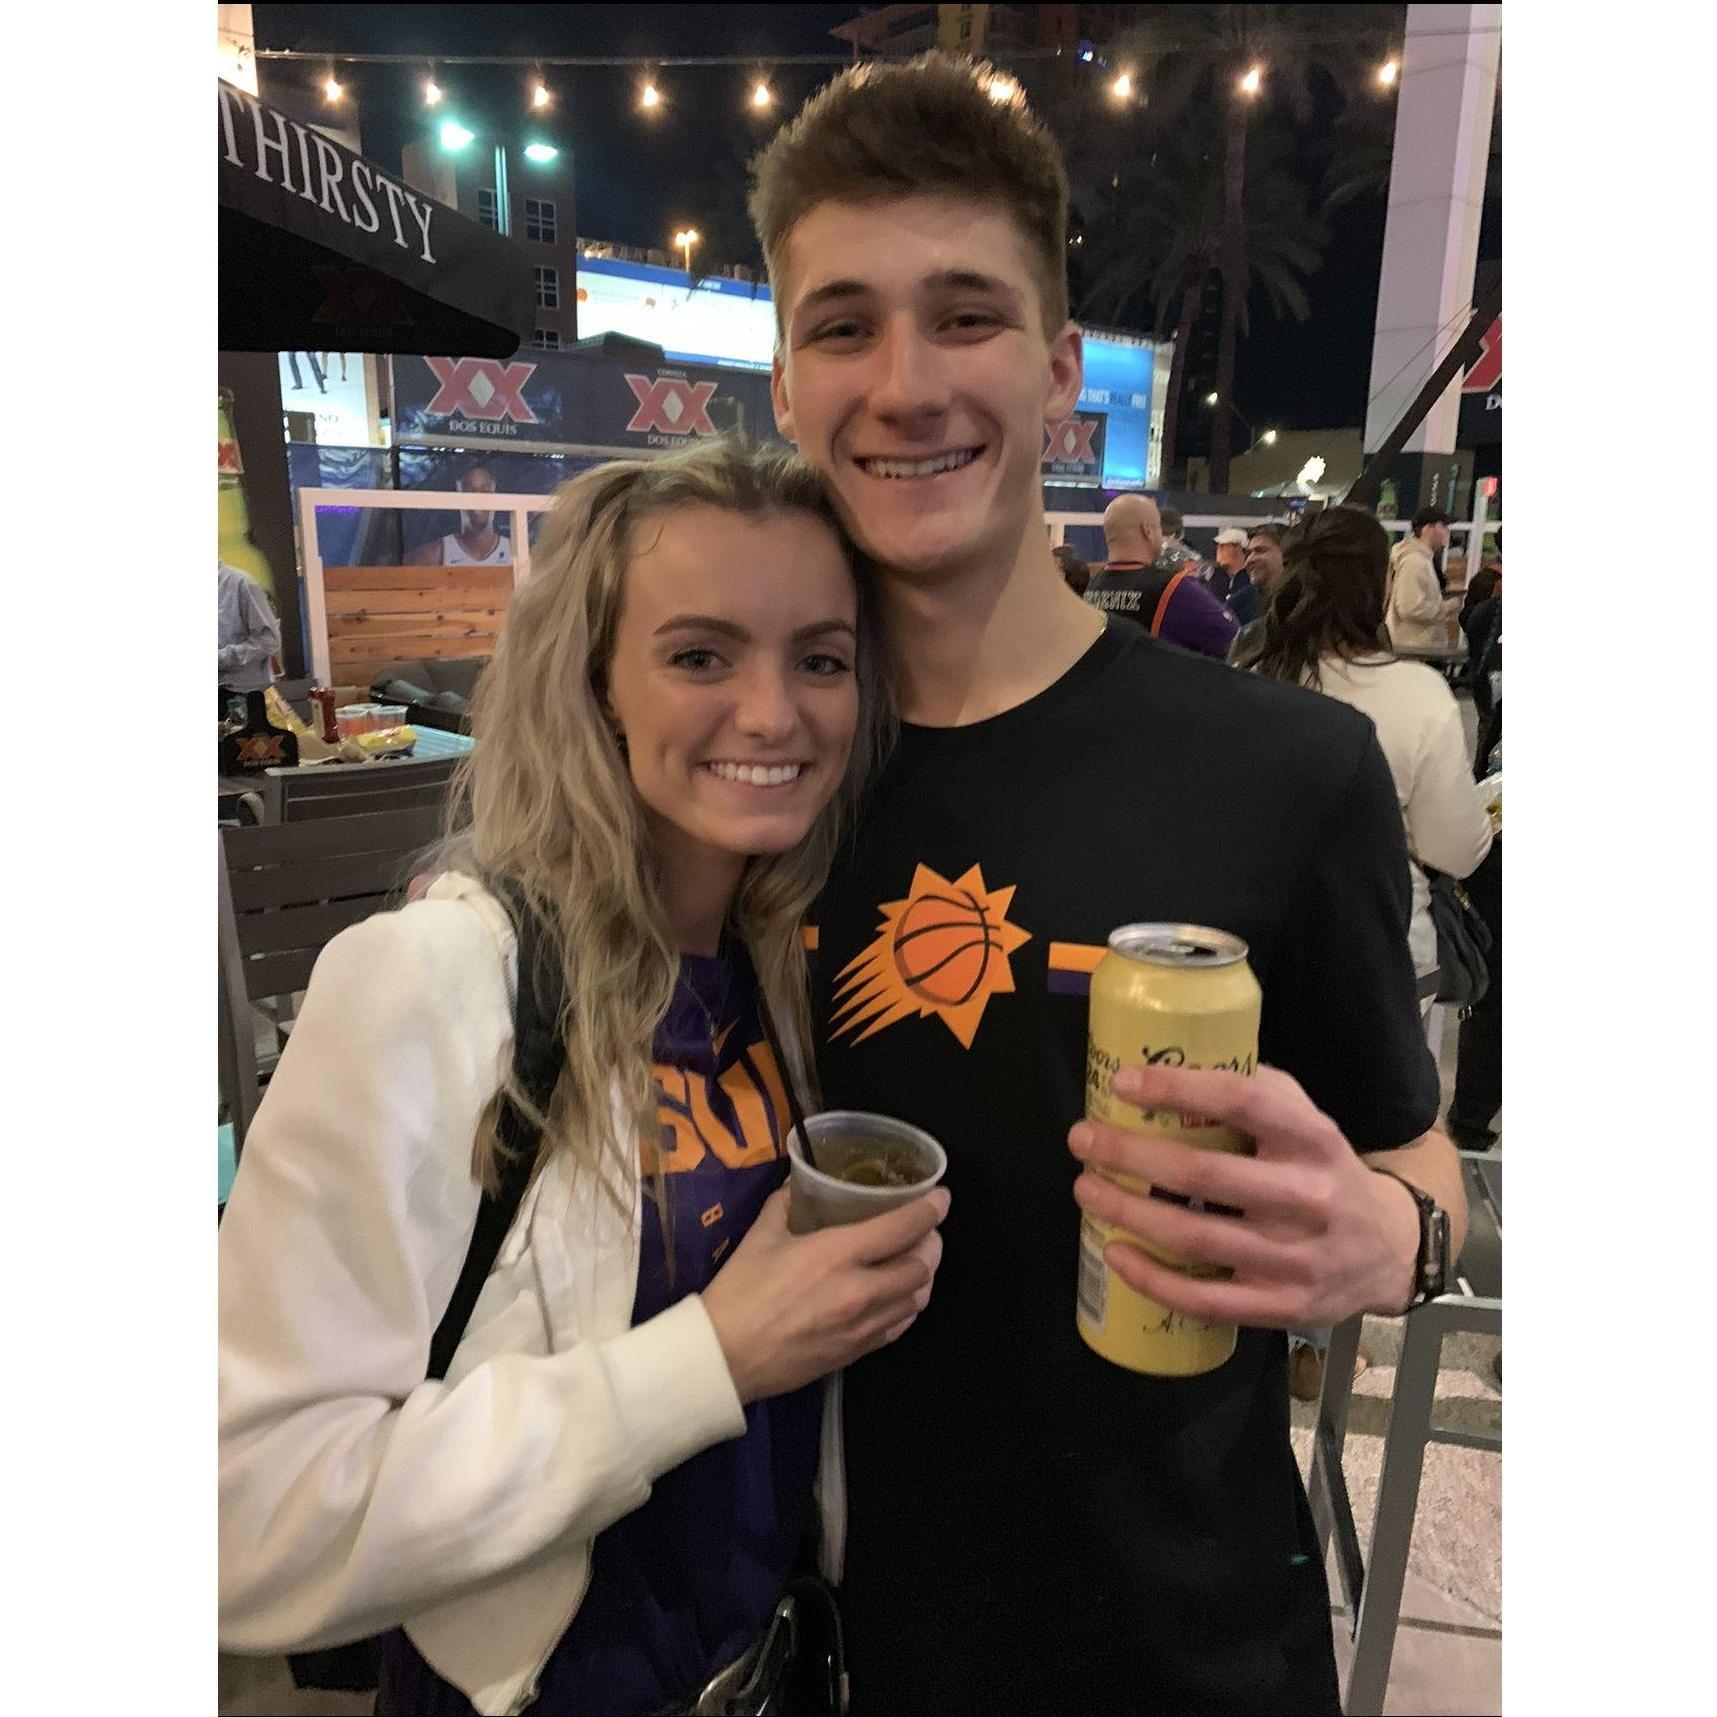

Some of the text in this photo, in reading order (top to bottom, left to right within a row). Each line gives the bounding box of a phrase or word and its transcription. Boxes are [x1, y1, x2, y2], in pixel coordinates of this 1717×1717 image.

[218, 86, 437, 264] THIRSTY
[424, 356, 538, 424] XX
[624, 374, 719, 437] XX
[1486, 394, 1502, 411] D
[449, 420, 518, 436] DOS EQUIS
